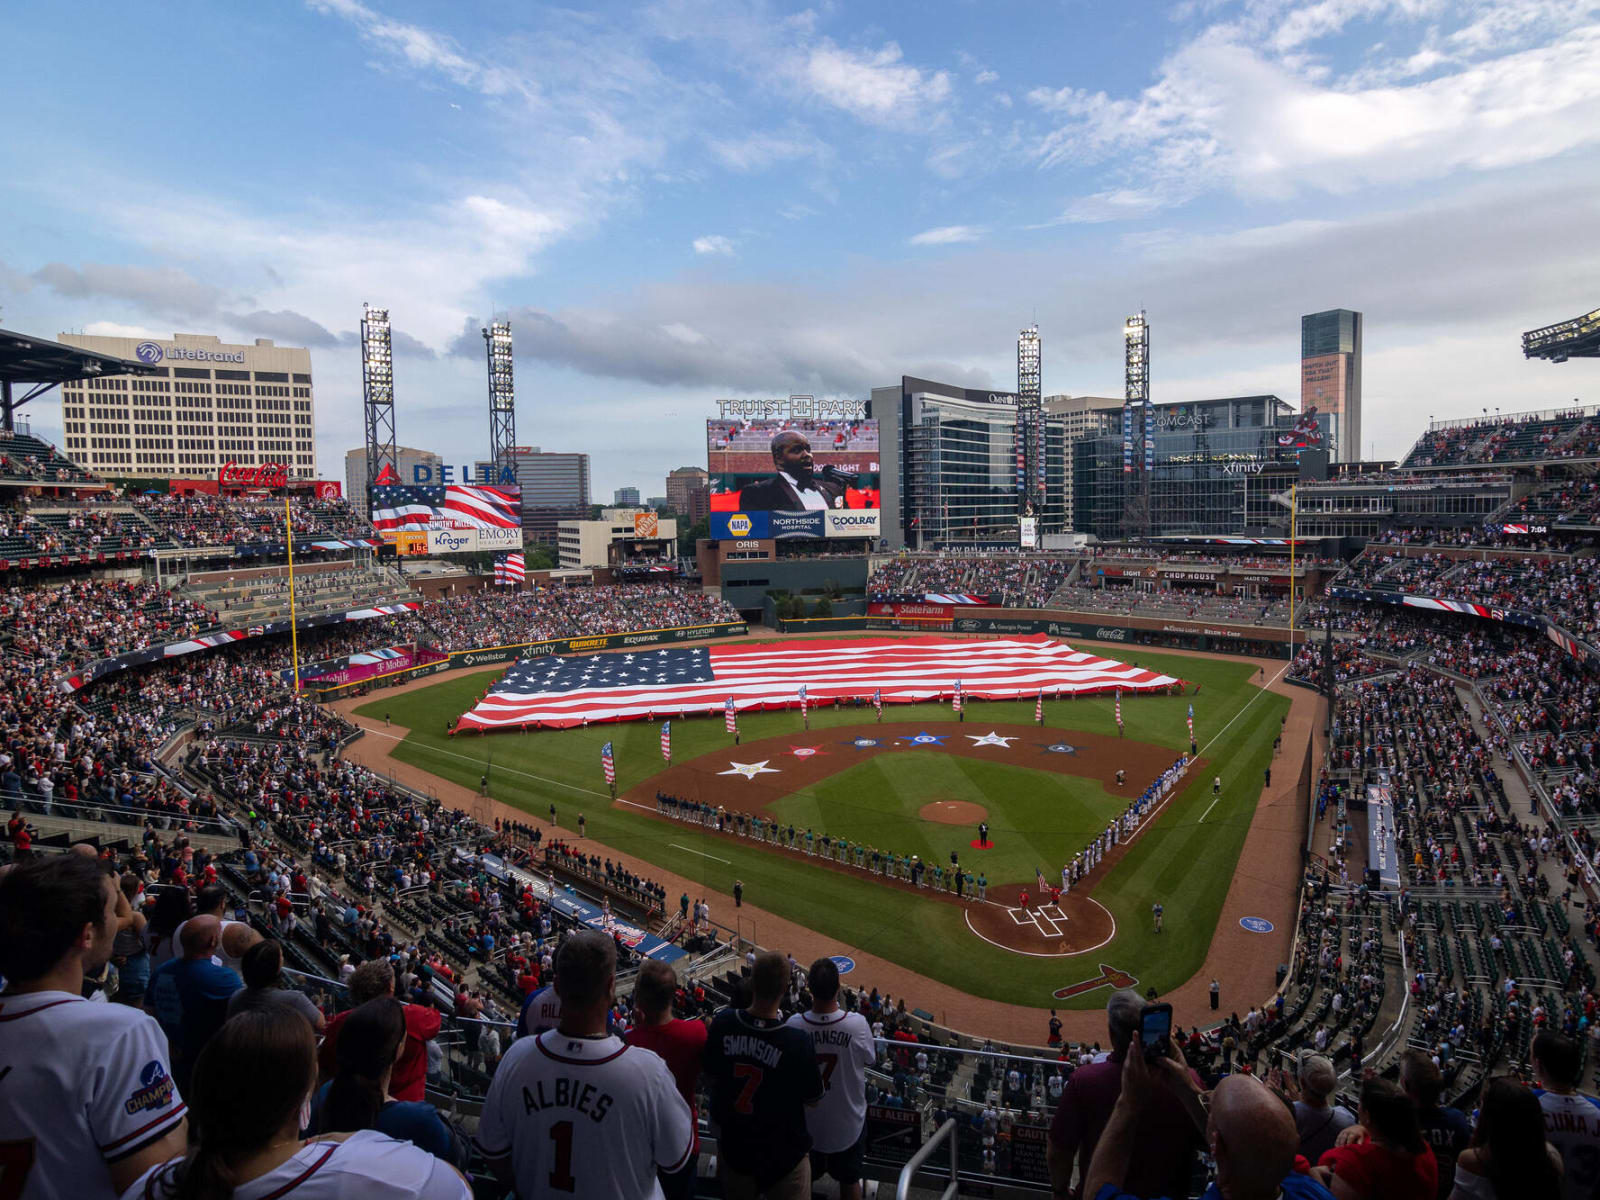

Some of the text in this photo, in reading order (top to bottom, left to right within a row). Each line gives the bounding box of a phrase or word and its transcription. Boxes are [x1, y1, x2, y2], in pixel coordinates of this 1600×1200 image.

[166, 347, 244, 363] LifeBrand
[716, 399, 867, 415] TRUIST PARK
[220, 460, 290, 488] Coca-Cola
[413, 464, 516, 484] DELTA
[1223, 462, 1265, 475] xfinity
[731, 520, 750, 530] NAPA
[833, 516, 878, 525] COOLRAY
[479, 528, 520, 539] EMORY
[1531, 525, 1547, 534] 7:04
[435, 532, 469, 551] Kroger
[1164, 572, 1216, 581] CHOP HOUSE
[687, 627, 715, 636] HYUNDAI
[1096, 628, 1126, 640] Coca-Cola
[569, 638, 609, 649] QUIKRETE
[624, 634, 660, 645] EQUIFAX
[522, 644, 556, 657] xfinity
[386, 657, 410, 670] Mobile
[476, 653, 507, 663] Wellstar
[807, 1029, 852, 1049] WANSON
[722, 1032, 784, 1070] SWANSON
[732, 1061, 763, 1115] 7
[522, 1077, 614, 1124] ALBIES
[885, 1110, 916, 1123] ALERT
[1543, 1109, 1588, 1138] CUÑA
[548, 1119, 577, 1194] 1
